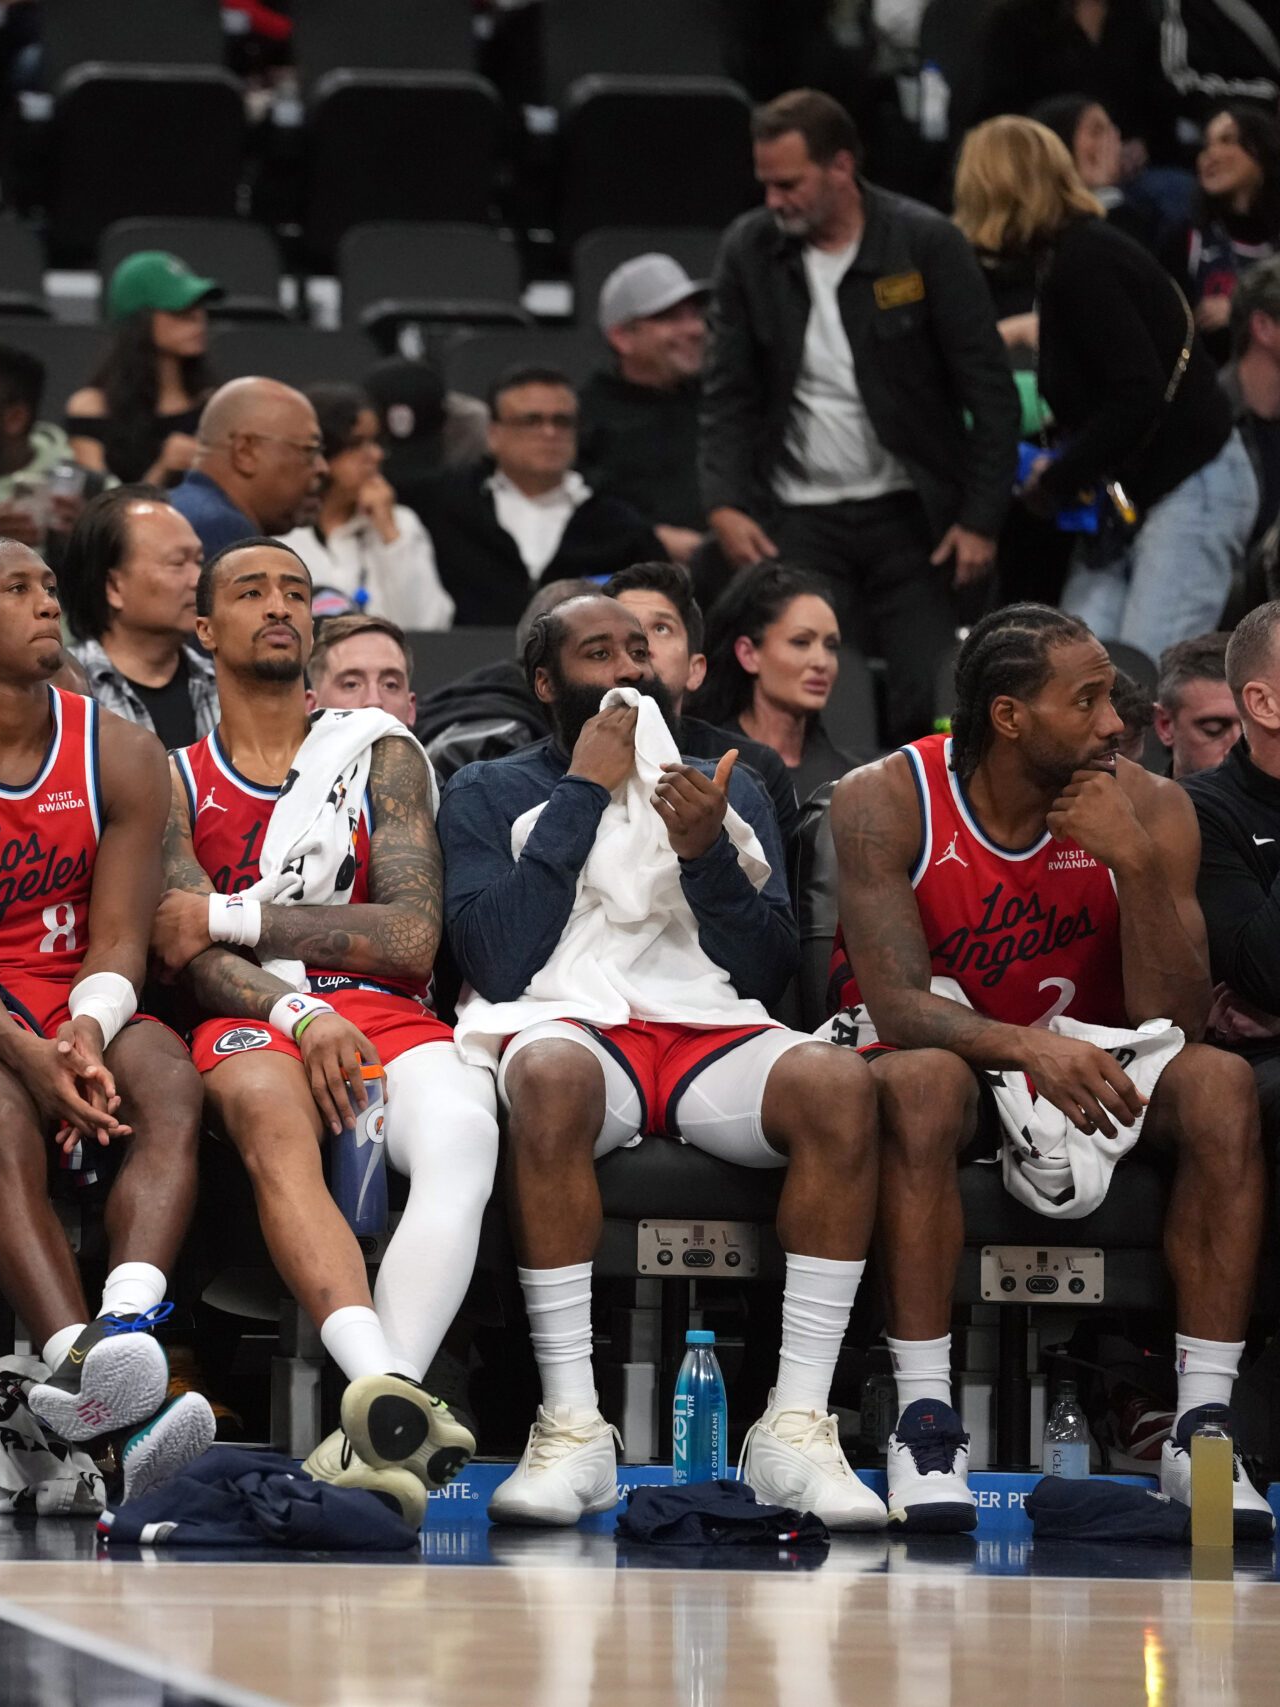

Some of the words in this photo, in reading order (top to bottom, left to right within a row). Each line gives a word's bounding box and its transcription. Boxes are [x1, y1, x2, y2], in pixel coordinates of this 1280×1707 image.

[38, 798, 86, 813] RWANDA
[47, 790, 73, 802] VISIT
[1048, 858, 1097, 871] RWANDA
[1056, 849, 1086, 860] VISIT
[39, 901, 77, 953] 8
[973, 881, 1046, 937] Los
[931, 903, 1098, 988] Angeles
[1028, 976, 1076, 1028] 2
[687, 1394, 695, 1418] WTR
[673, 1394, 687, 1461] zen
